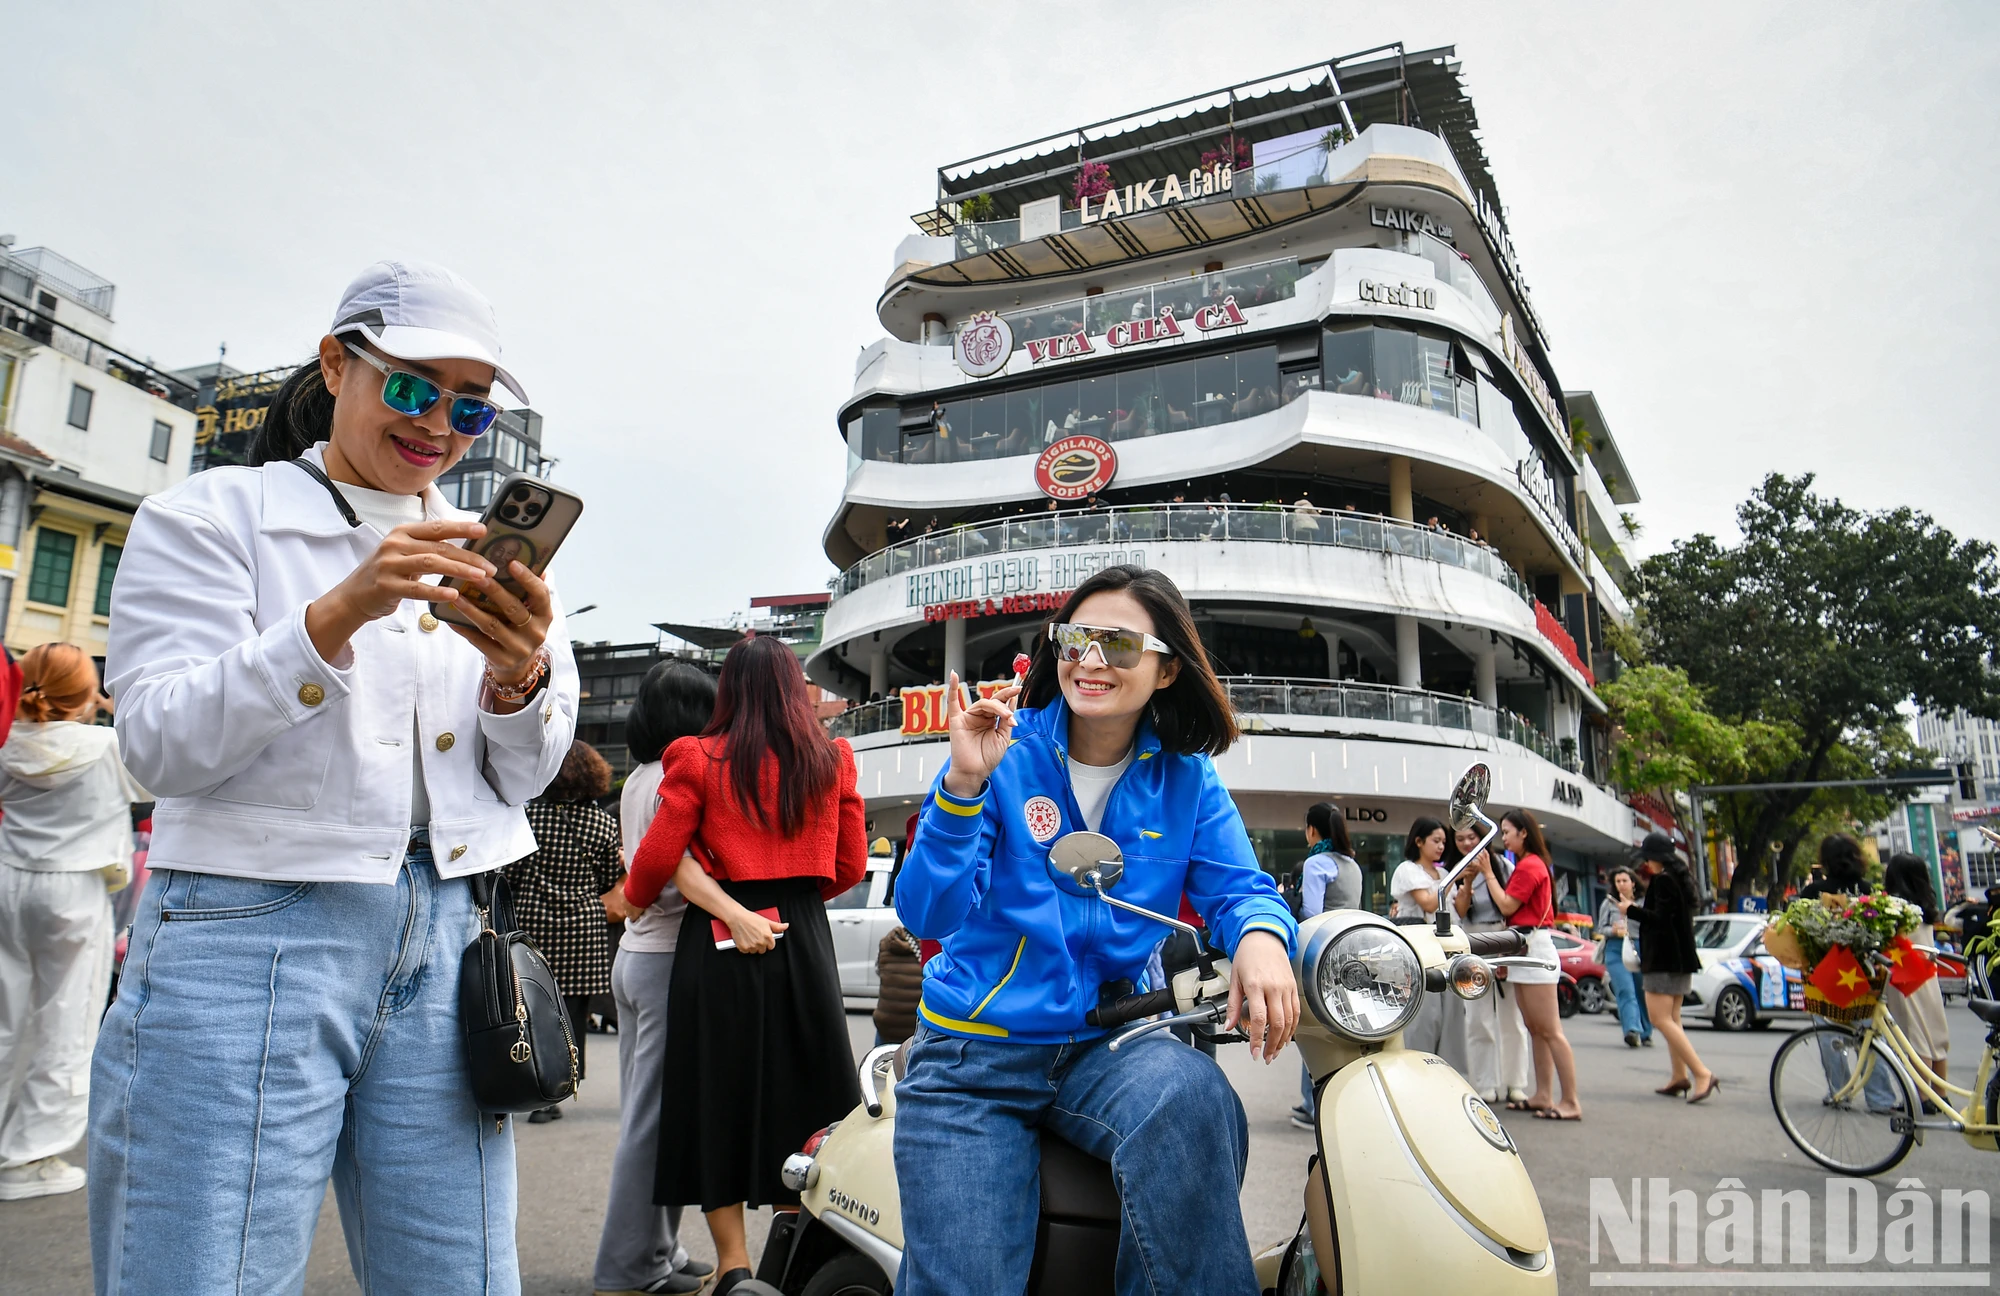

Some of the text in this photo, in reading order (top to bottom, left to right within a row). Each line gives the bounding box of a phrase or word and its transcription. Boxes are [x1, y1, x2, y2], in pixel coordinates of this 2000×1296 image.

[1081, 162, 1232, 224] LAIKA Café
[1371, 205, 1436, 235] LAIKA
[1360, 279, 1386, 302] Cơ
[1415, 286, 1437, 309] 10
[1024, 295, 1248, 364] VUA CHẢ CÁ
[1039, 439, 1111, 470] HIGHLANDS
[1048, 477, 1104, 497] COFFEE
[906, 565, 974, 608] HANOI
[980, 556, 1038, 596] 1930
[924, 600, 980, 623] COFFEE
[984, 598, 997, 615] &
[1552, 779, 1583, 807] ALDO
[1345, 807, 1387, 822] LDO
[829, 1187, 880, 1226] Giorno
